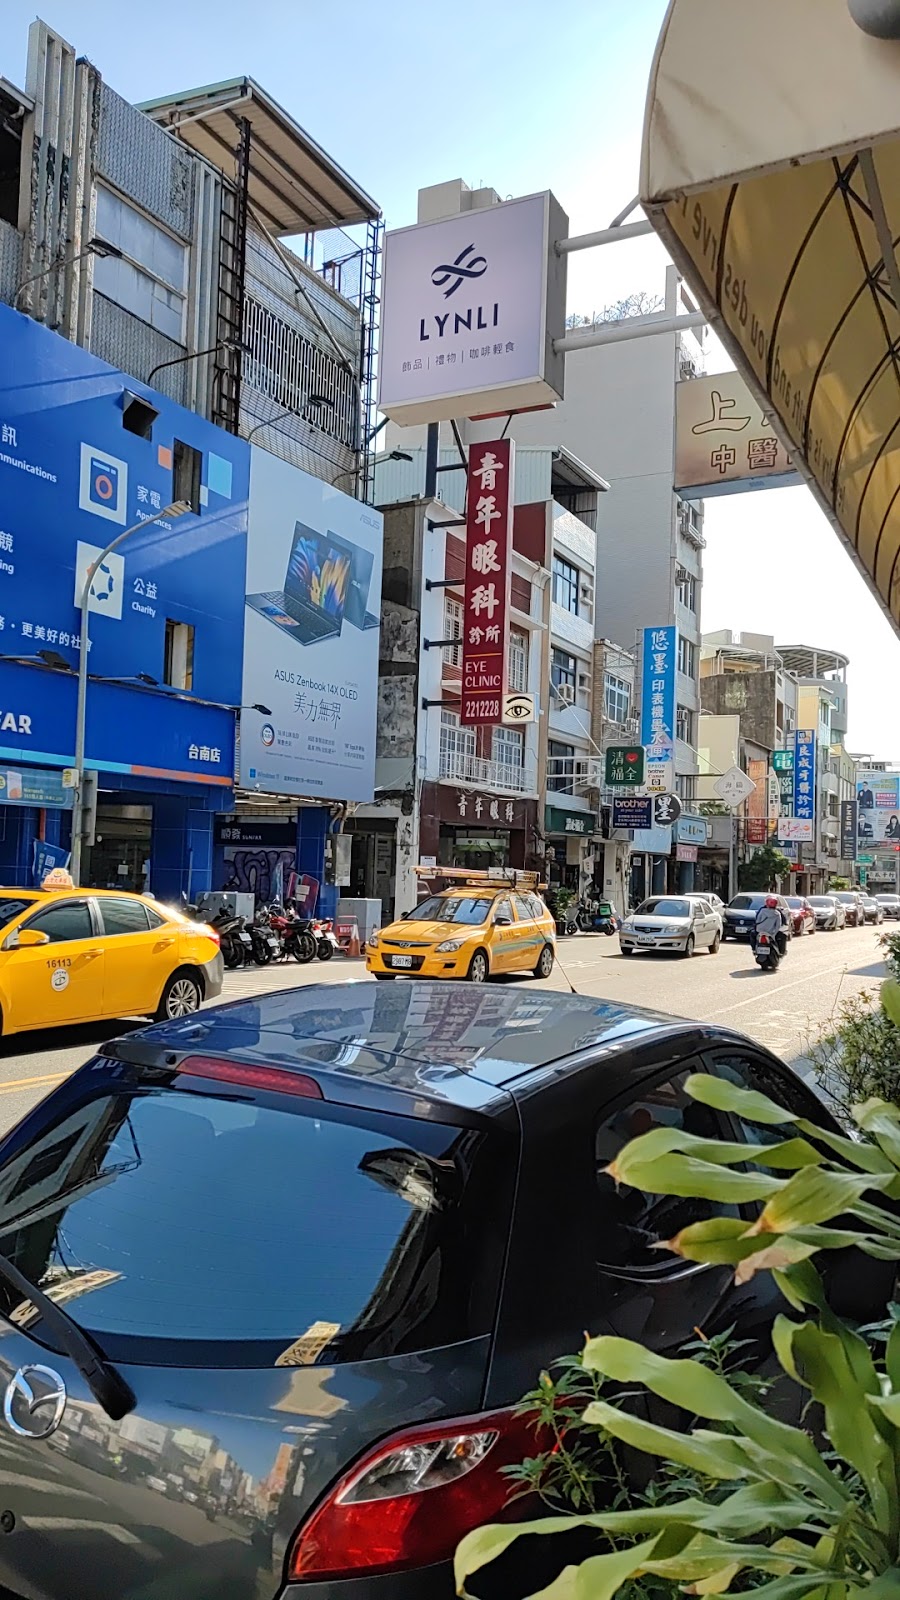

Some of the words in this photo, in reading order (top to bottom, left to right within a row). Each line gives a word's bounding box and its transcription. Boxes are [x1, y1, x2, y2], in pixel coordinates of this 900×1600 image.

[419, 303, 499, 342] LYNLI
[402, 358, 423, 373] 飾品
[435, 351, 457, 366] 禮物
[469, 340, 515, 360] 咖啡輕食
[692, 390, 773, 435] 上
[2, 423, 18, 448] 訊
[710, 438, 797, 475] 中醫
[136, 485, 161, 509] 家電
[359, 513, 380, 530] ASUS
[469, 451, 504, 619] 青年眼科
[133, 577, 158, 600] 公益
[131, 601, 157, 618] Charity
[468, 624, 501, 646] 診所
[650, 629, 670, 675] 悠墨
[465, 660, 487, 674] EYE
[274, 669, 295, 684] ASUS
[296, 674, 327, 692] Zenbook
[327, 683, 339, 696] 14X
[339, 687, 358, 701] OLED
[464, 674, 501, 688] CLINIC
[293, 691, 341, 730] 美力無界
[465, 699, 500, 718] 2212228
[0, 711, 32, 735] AR
[188, 743, 222, 763] 台南店
[457, 793, 515, 823] 青年眼科
[615, 799, 650, 809] brother
[46, 958, 72, 969] 16113
